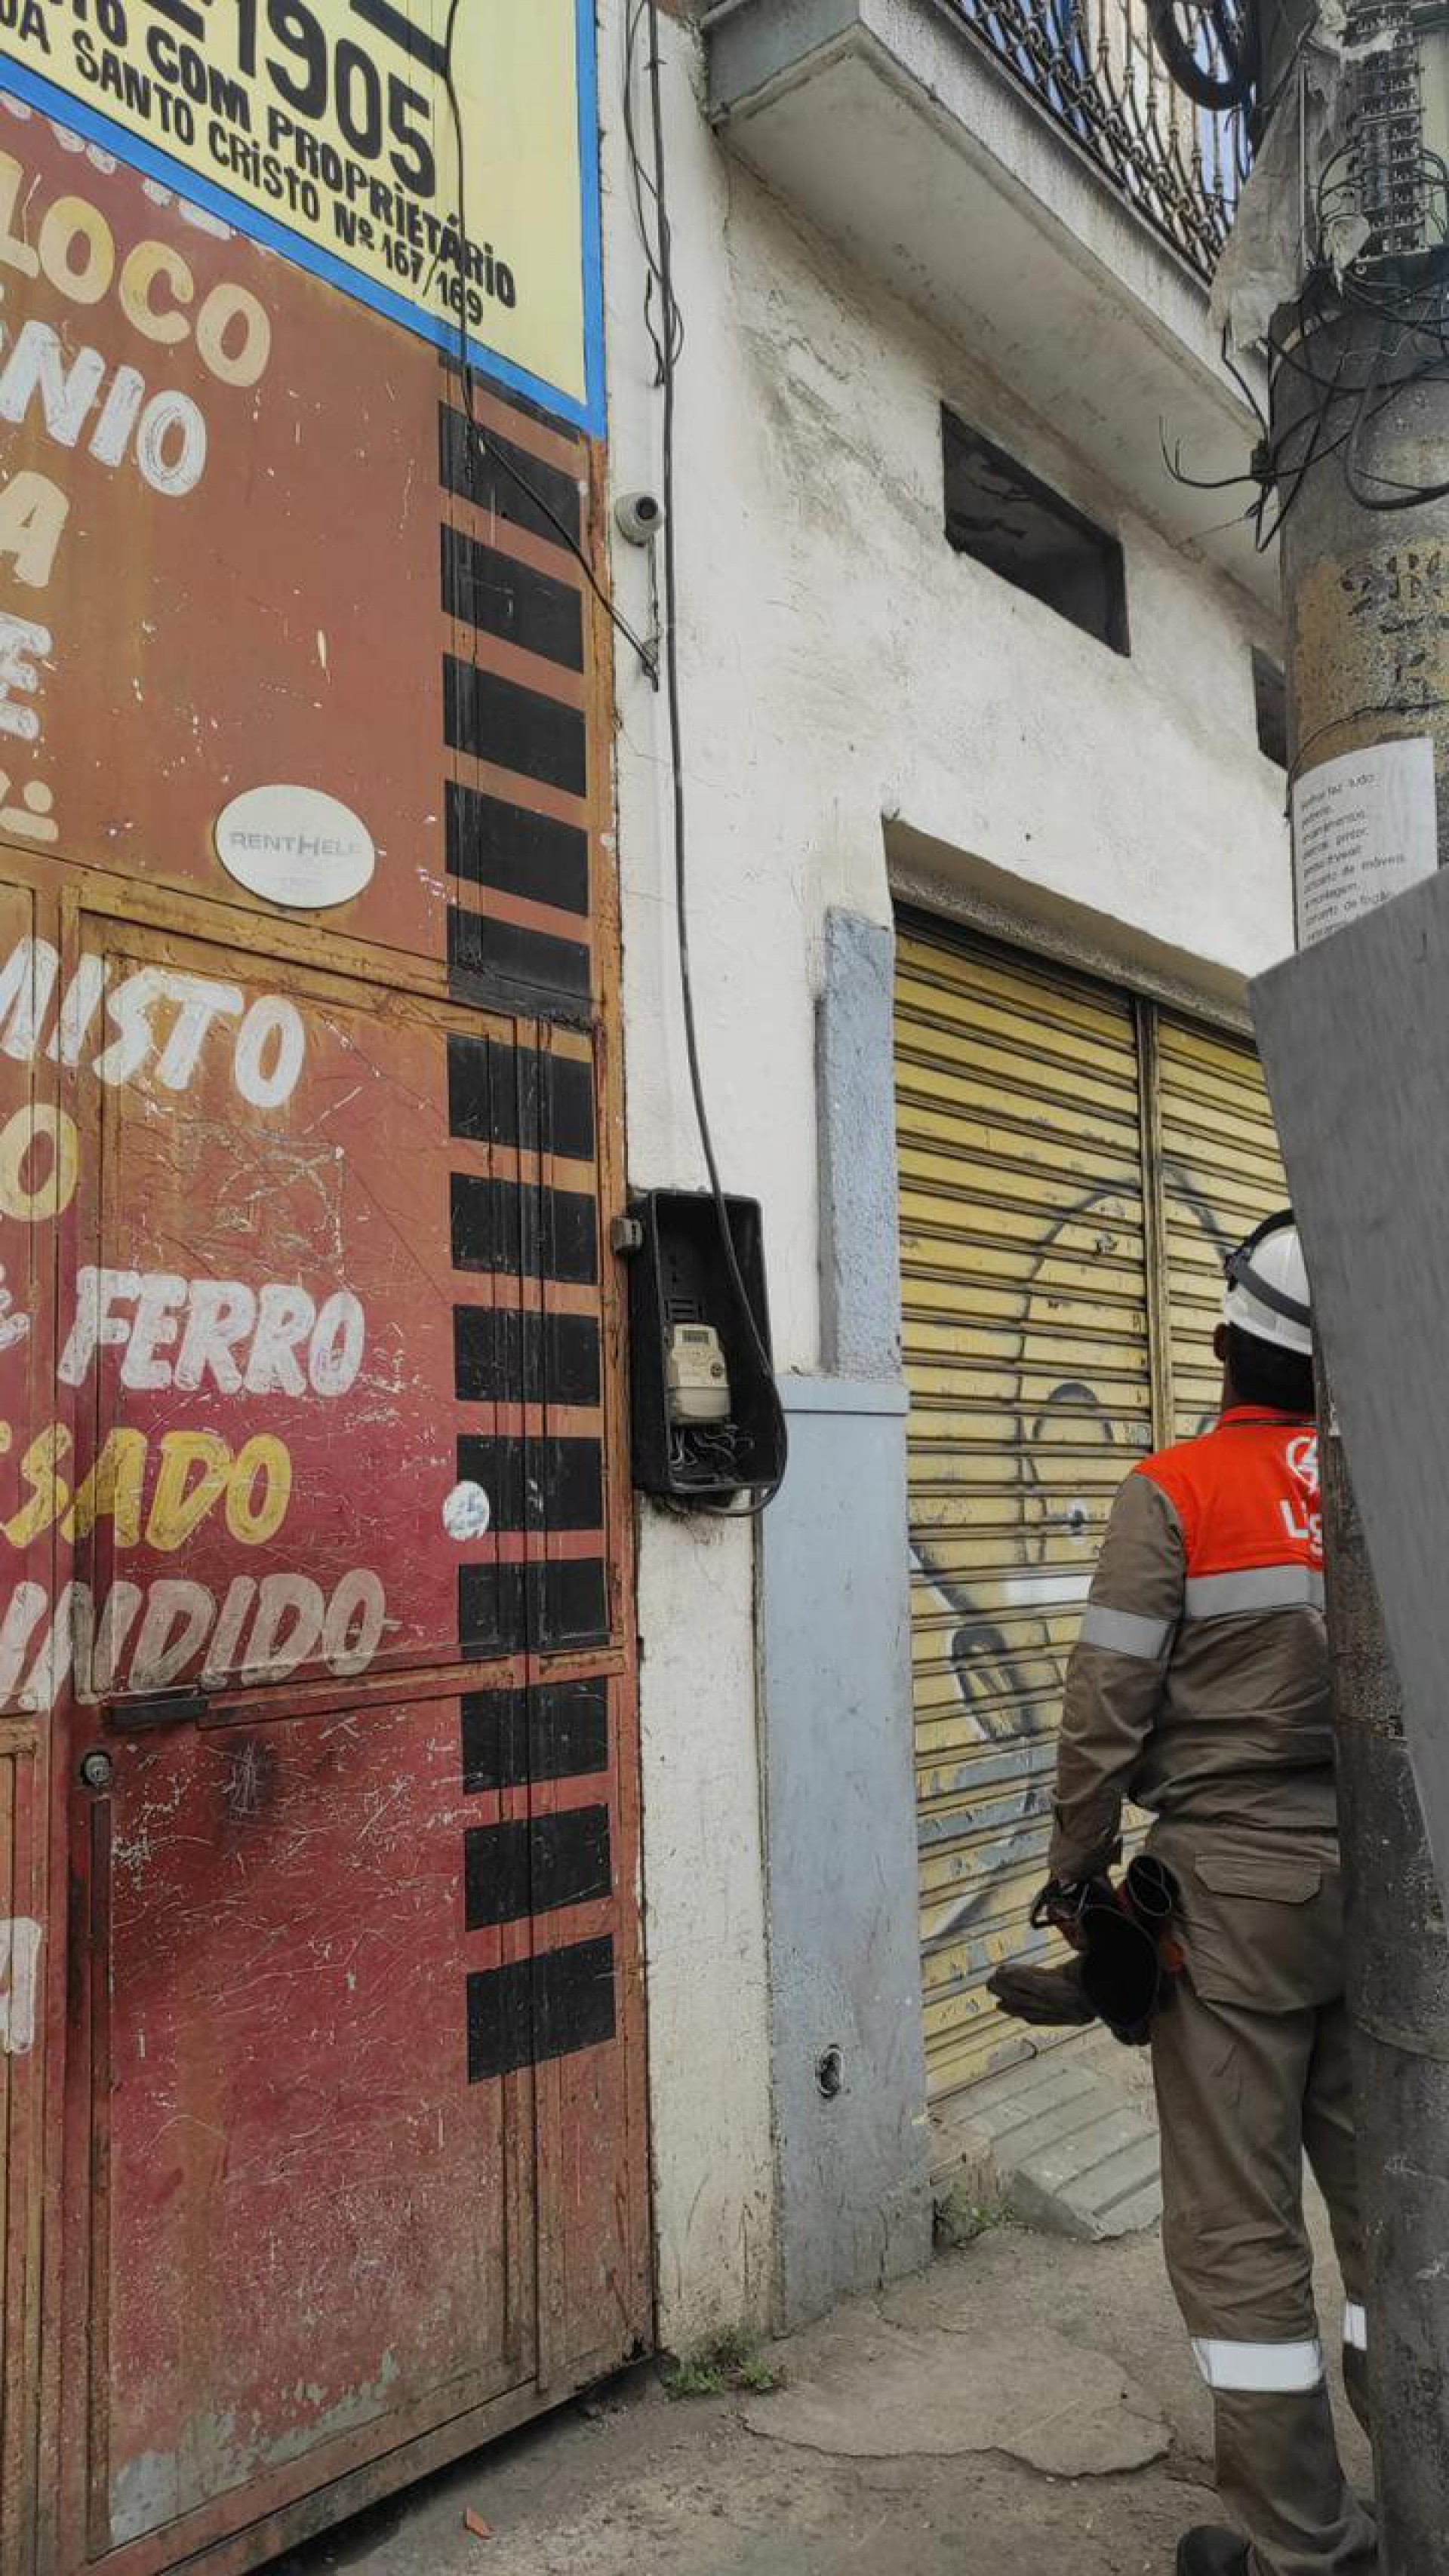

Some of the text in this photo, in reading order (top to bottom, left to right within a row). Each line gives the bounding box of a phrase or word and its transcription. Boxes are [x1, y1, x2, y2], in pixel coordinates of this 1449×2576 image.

[72, 30, 195, 146] SANTO
[208, 121, 320, 223] CRISTO
[146, 26, 252, 134] COM
[0, 153, 272, 387] LOCO
[57, 1265, 365, 1397] FERRO
[0, 1421, 291, 1551] SADO
